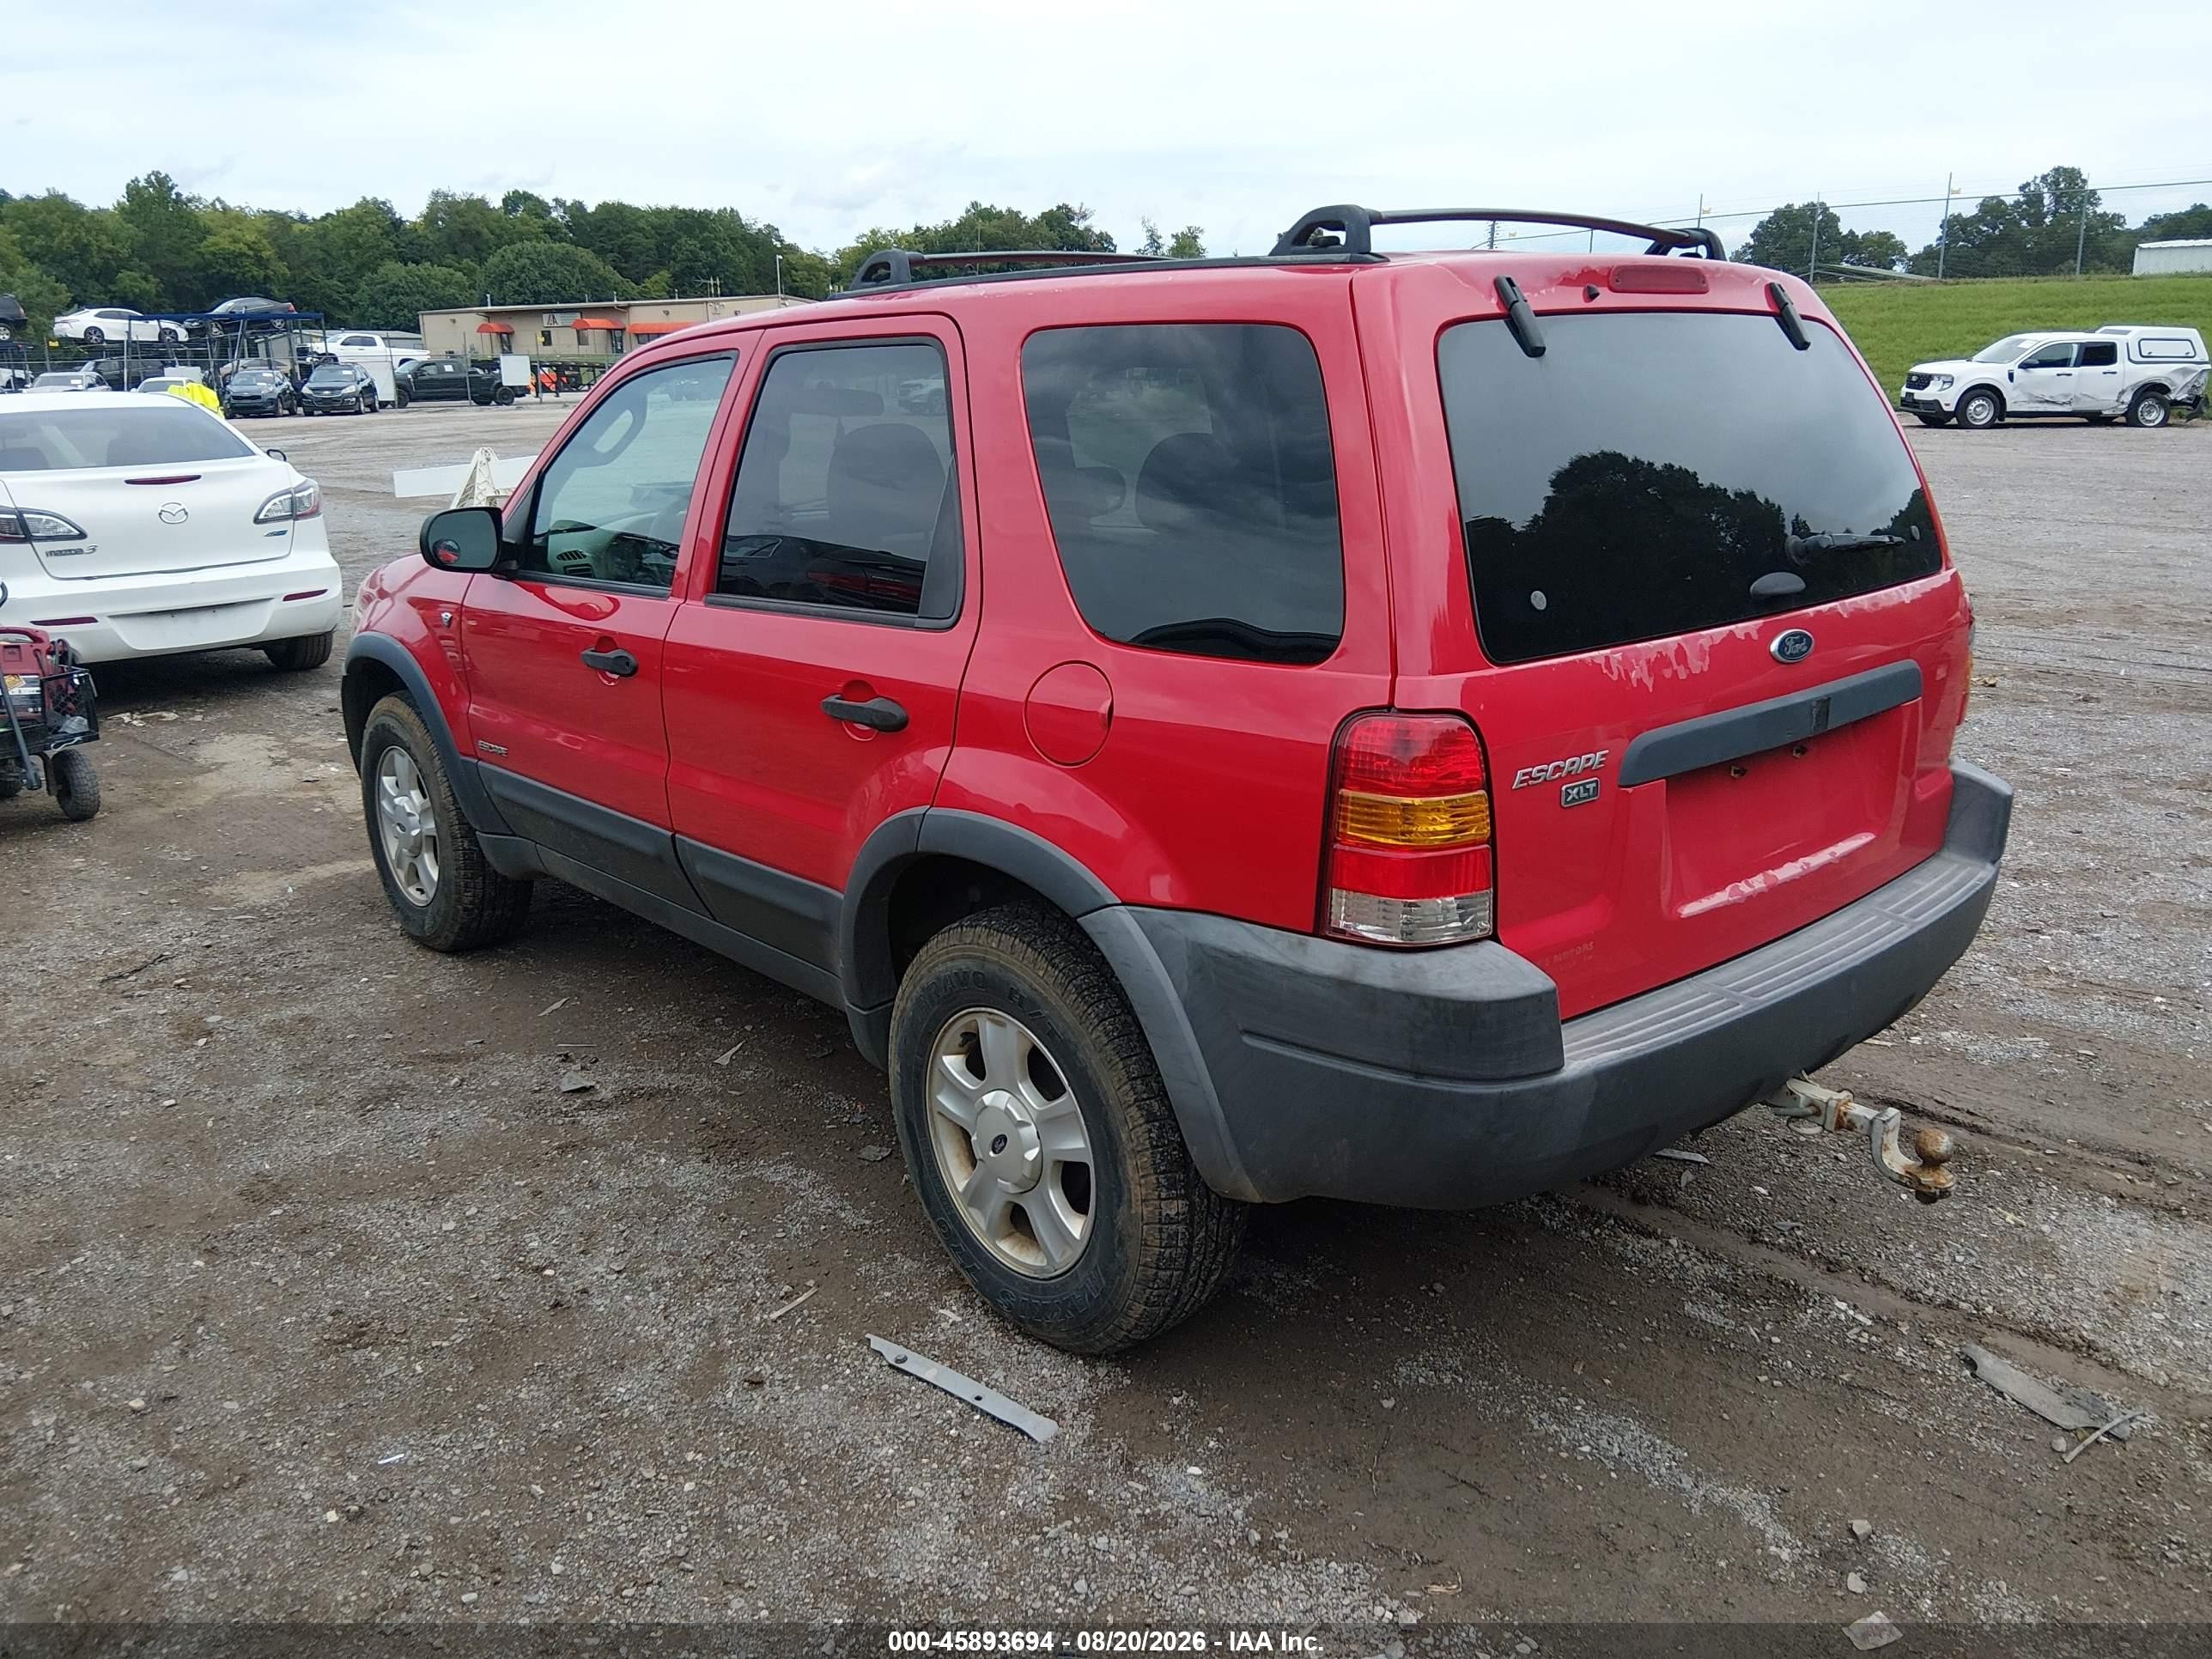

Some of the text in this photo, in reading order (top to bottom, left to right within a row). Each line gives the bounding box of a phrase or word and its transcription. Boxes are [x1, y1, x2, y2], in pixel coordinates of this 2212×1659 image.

[1784, 635, 1808, 655] Ford
[1511, 749, 1609, 790] ESCAPE
[1565, 782, 1596, 802] XLT
